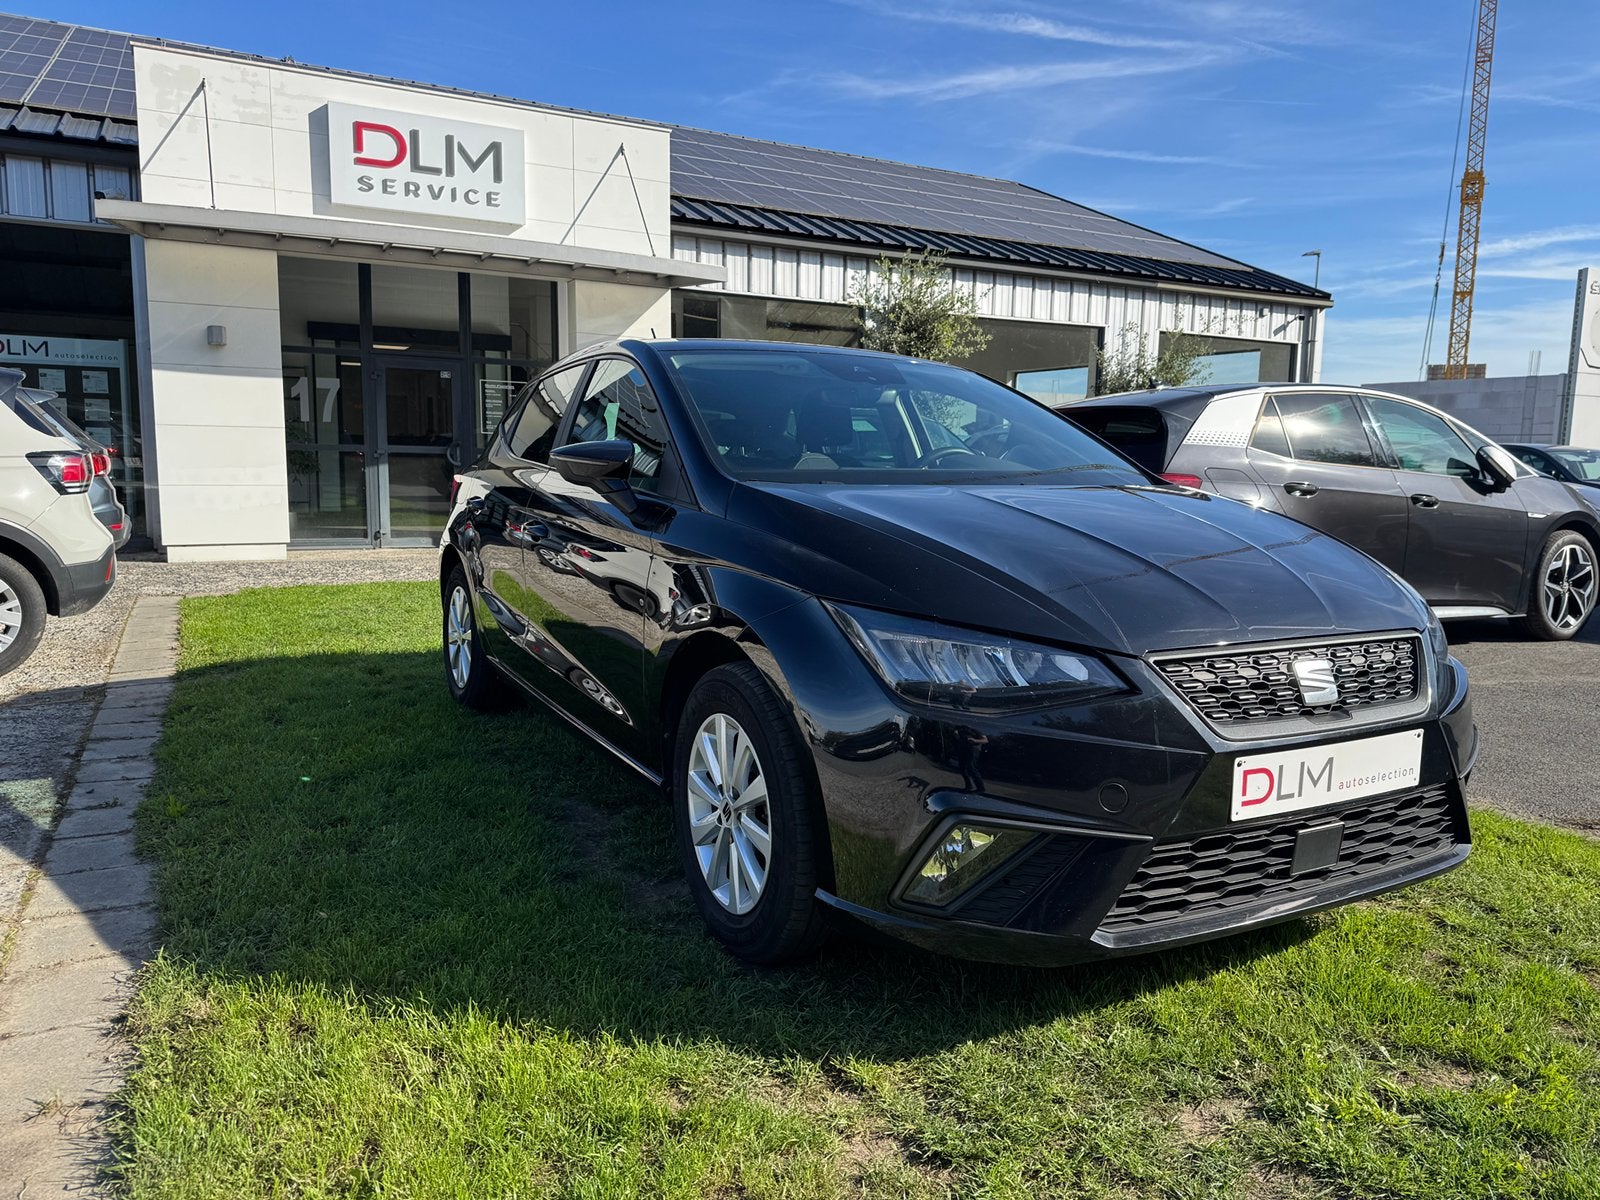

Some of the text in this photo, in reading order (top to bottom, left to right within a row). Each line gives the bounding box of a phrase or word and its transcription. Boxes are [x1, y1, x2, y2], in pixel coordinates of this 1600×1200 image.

[352, 120, 503, 184] DLM
[357, 175, 501, 208] SERVICE
[0, 338, 119, 361] LM autoselection
[290, 376, 341, 423] 17
[1241, 756, 1415, 807] DLM autoselection
